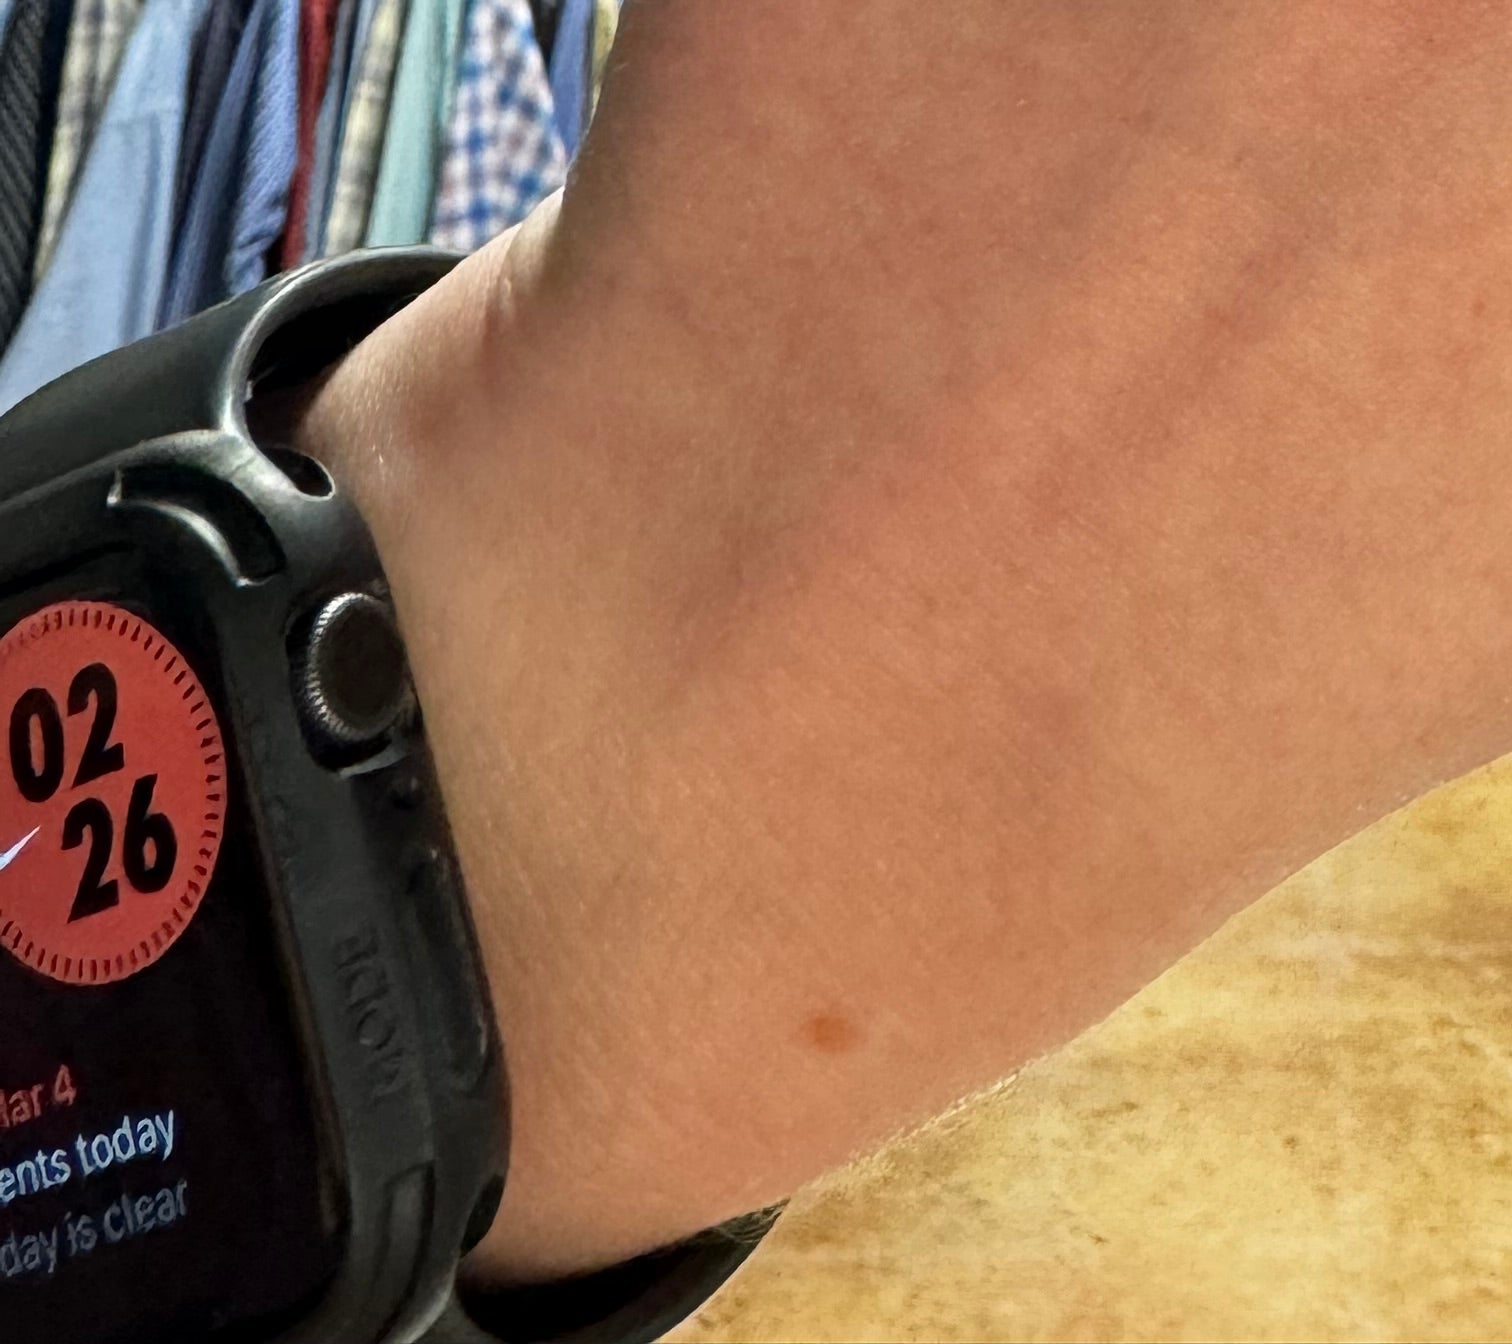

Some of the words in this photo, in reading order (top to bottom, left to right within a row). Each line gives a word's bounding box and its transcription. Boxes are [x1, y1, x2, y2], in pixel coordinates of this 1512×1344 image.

[9, 662, 124, 802] 02
[61, 773, 177, 923] 26
[53, 1064, 77, 1106] 4
[0, 1149, 71, 1204] ents
[75, 1109, 175, 1175] today
[0, 1226, 58, 1277] day
[63, 1211, 98, 1256] is
[103, 1178, 188, 1243] clear
